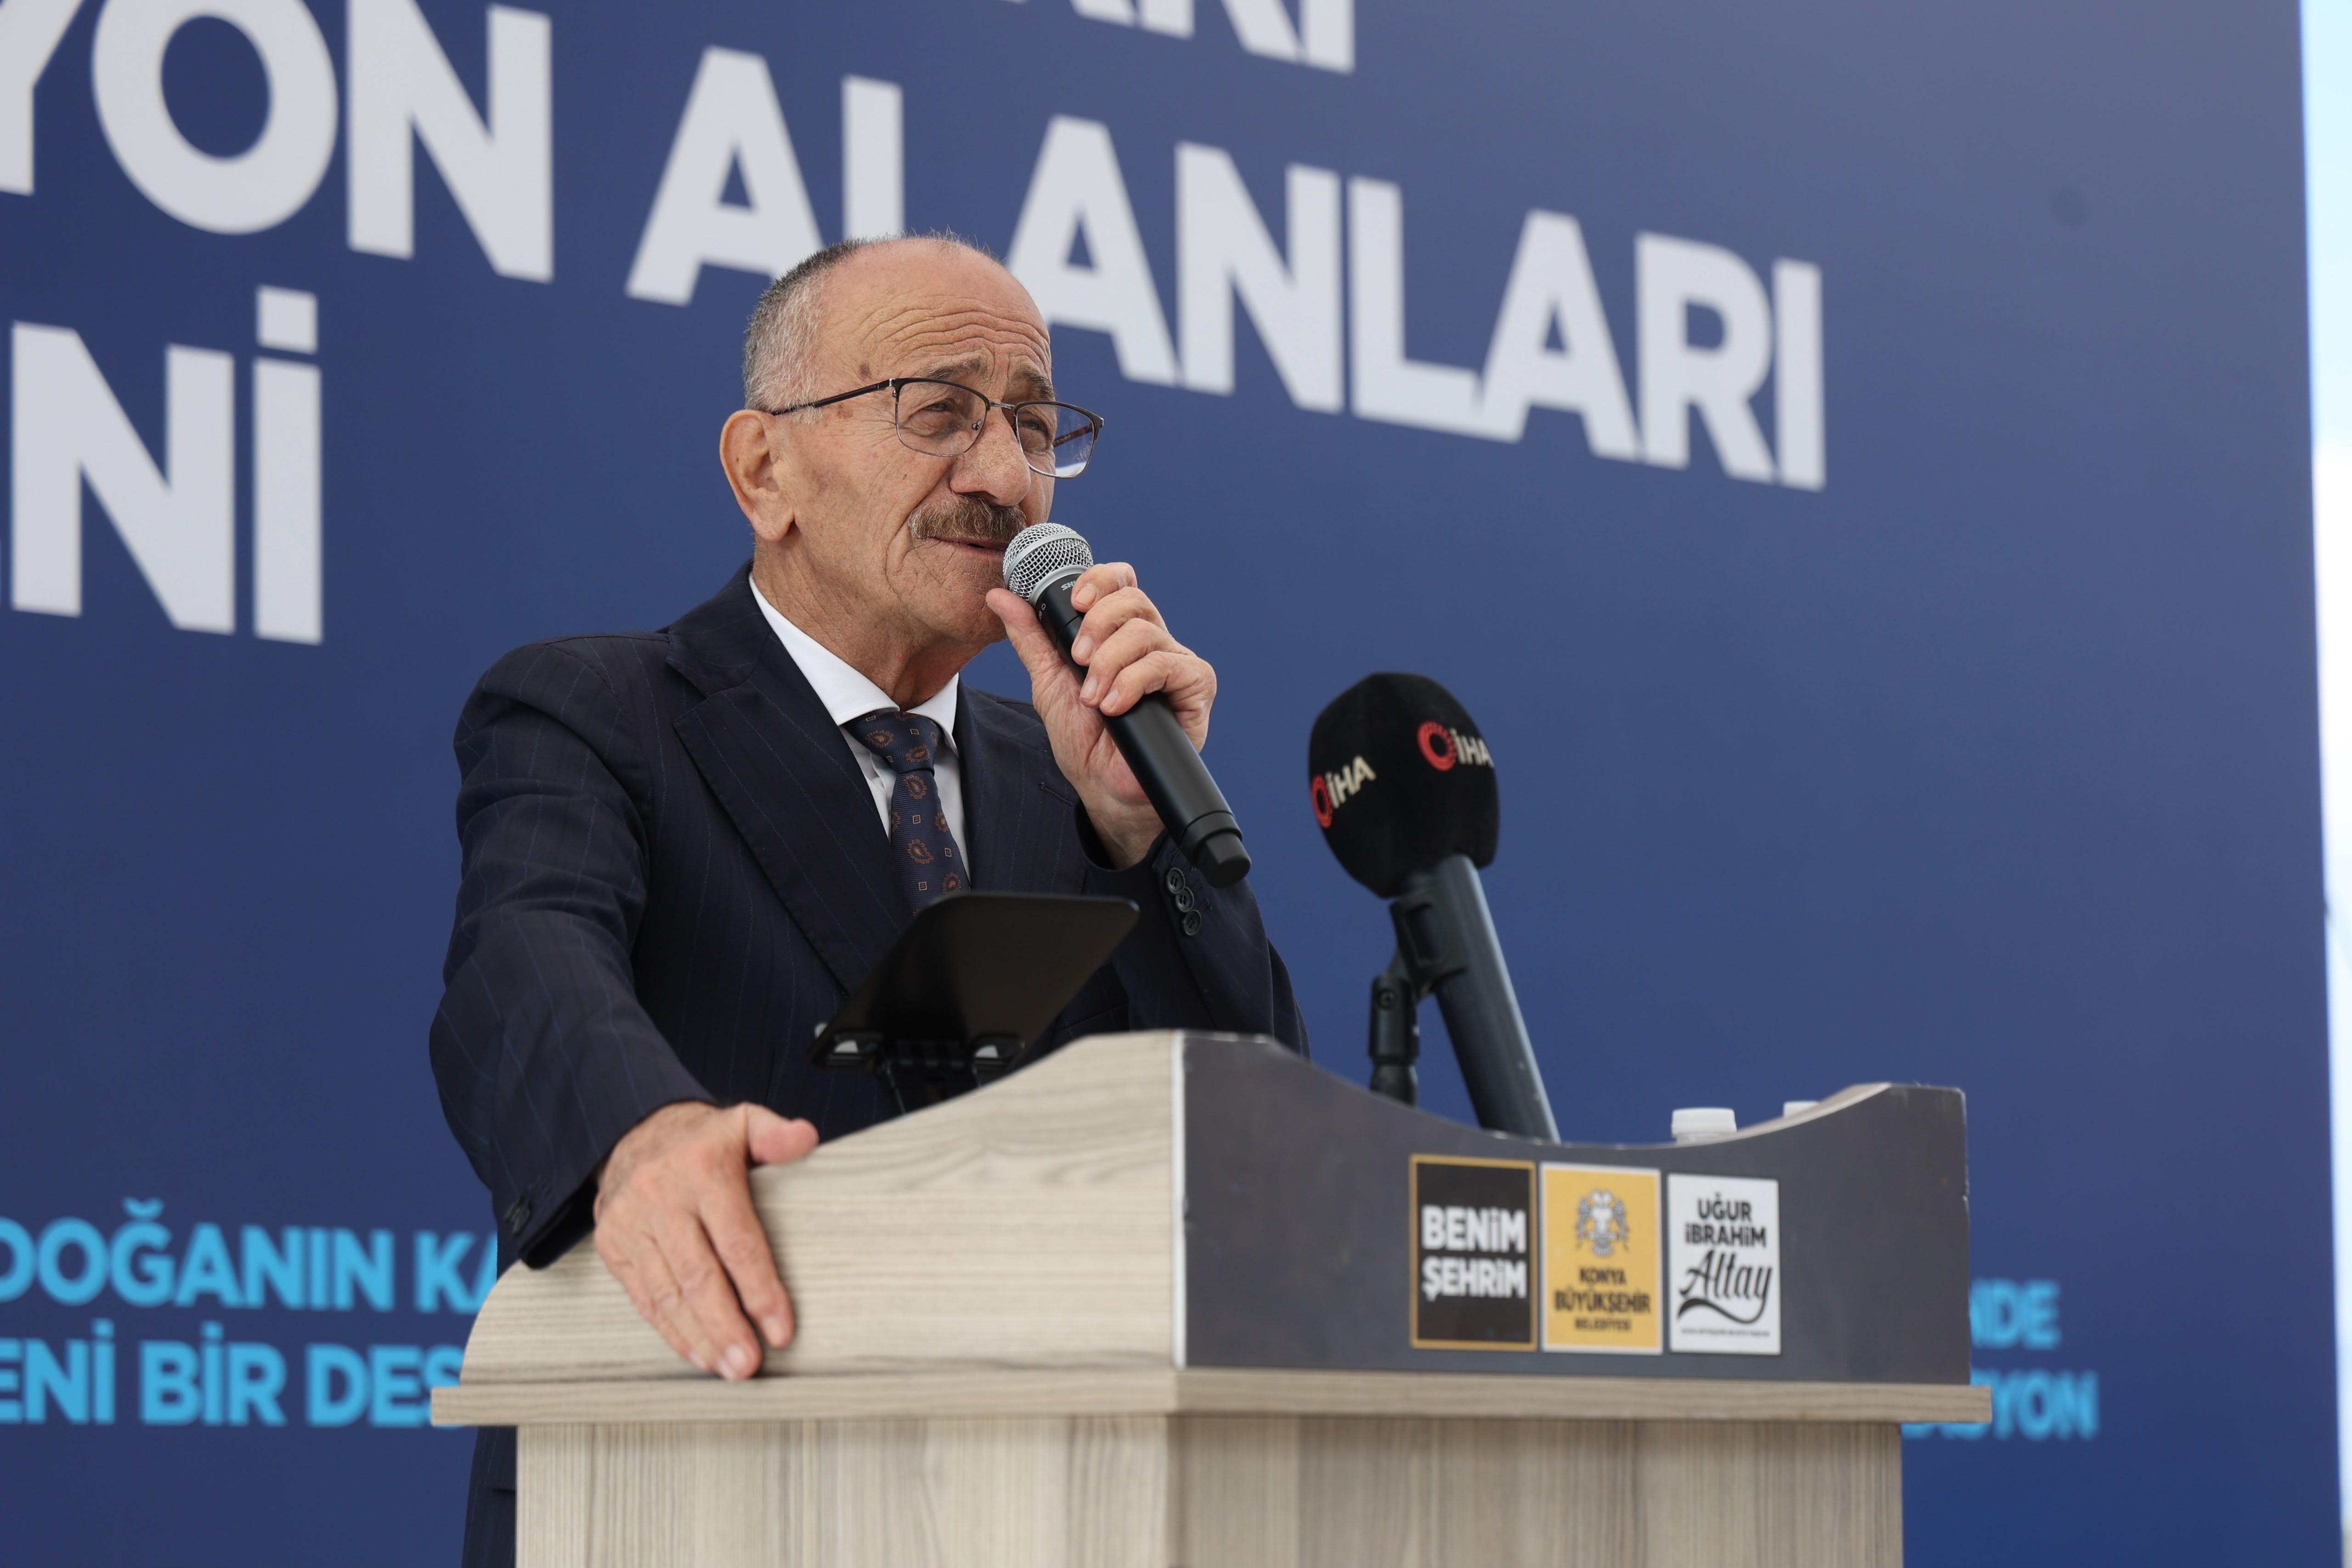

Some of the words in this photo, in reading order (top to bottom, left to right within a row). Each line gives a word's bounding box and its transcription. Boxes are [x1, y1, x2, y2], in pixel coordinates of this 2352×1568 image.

[1450, 728, 1494, 767] İHA
[1326, 756, 1375, 808] İHA
[1698, 1193, 1752, 1222] UĞUR
[1579, 1267, 1627, 1286] KONYA
[1678, 1249, 1772, 1325] Altay
[141, 1321, 286, 1425] BİR
